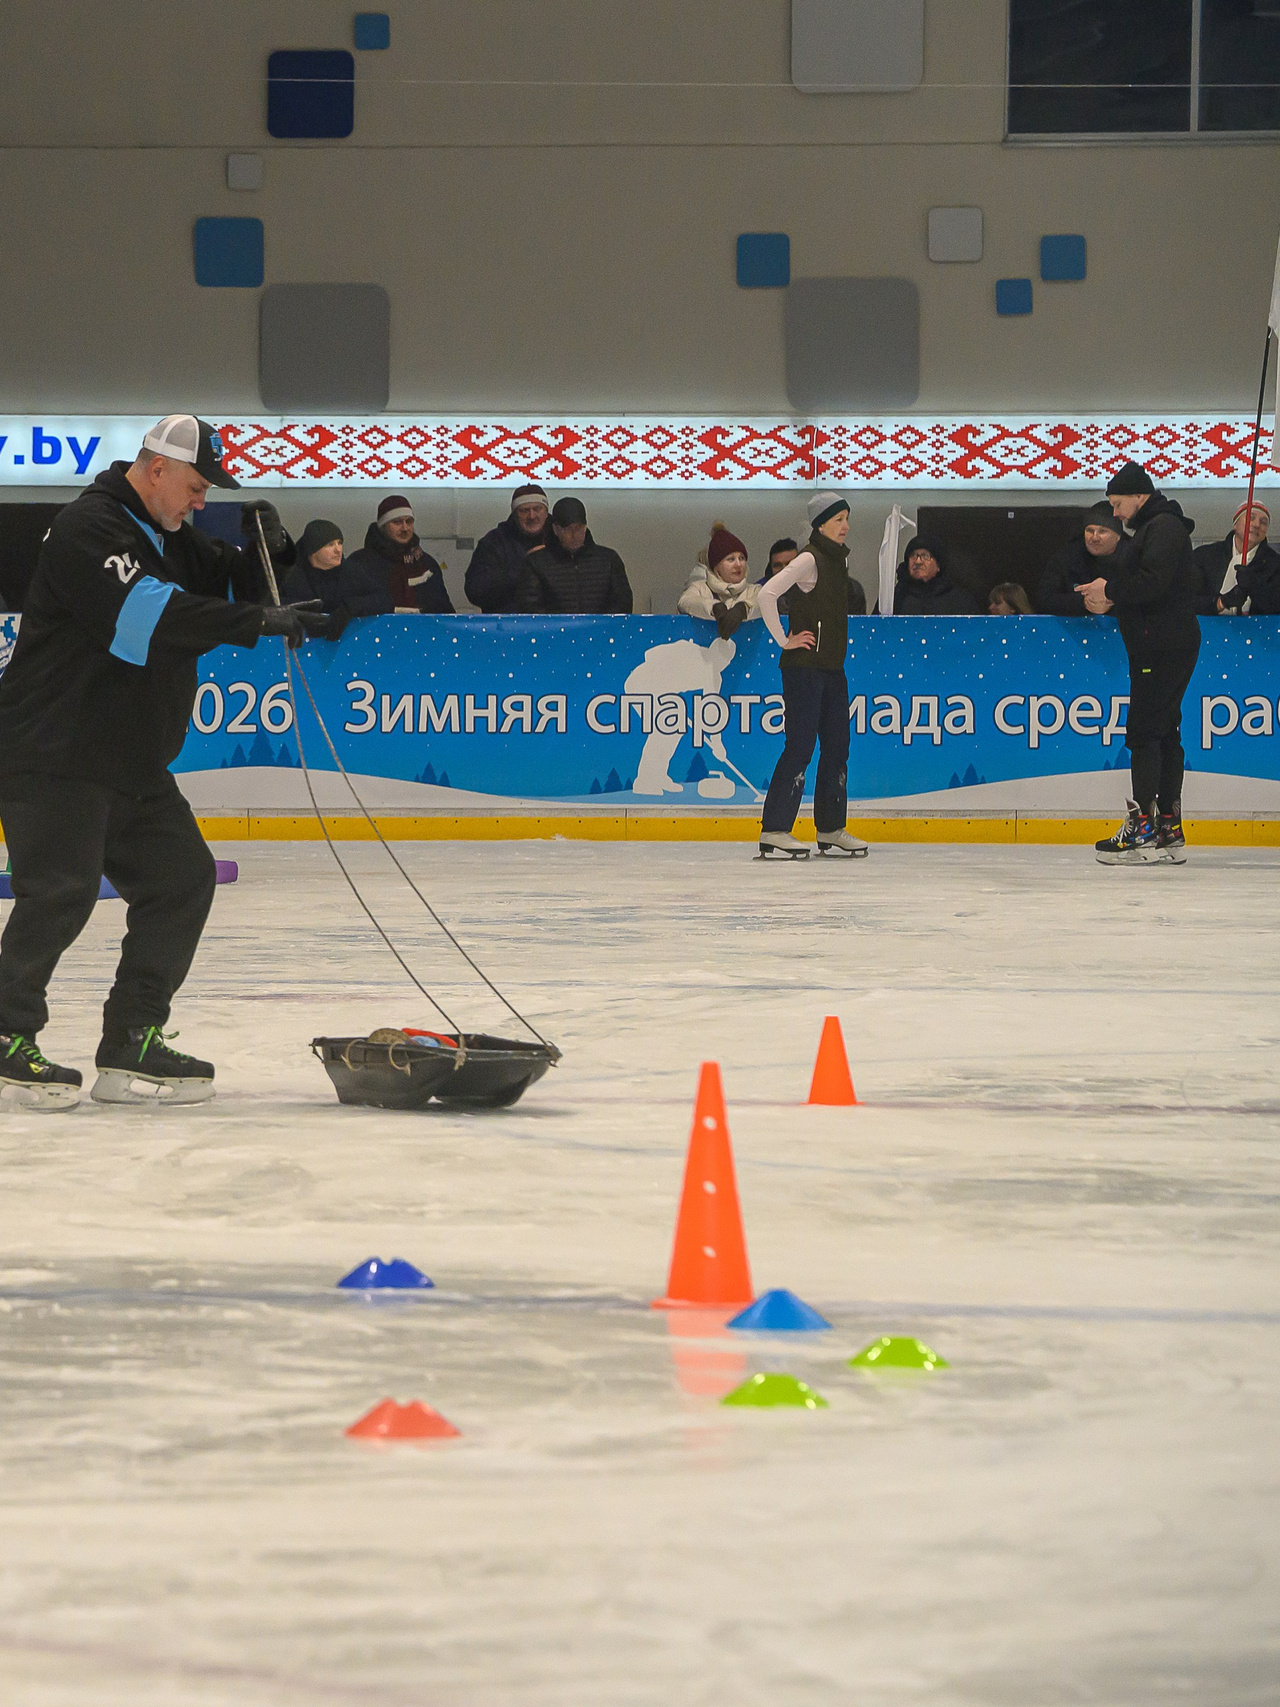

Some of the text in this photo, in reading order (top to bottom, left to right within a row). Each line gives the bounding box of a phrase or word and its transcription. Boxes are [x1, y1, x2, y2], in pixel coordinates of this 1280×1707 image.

[185, 679, 1280, 750] 026 Зимняя спартаиада сред ра
